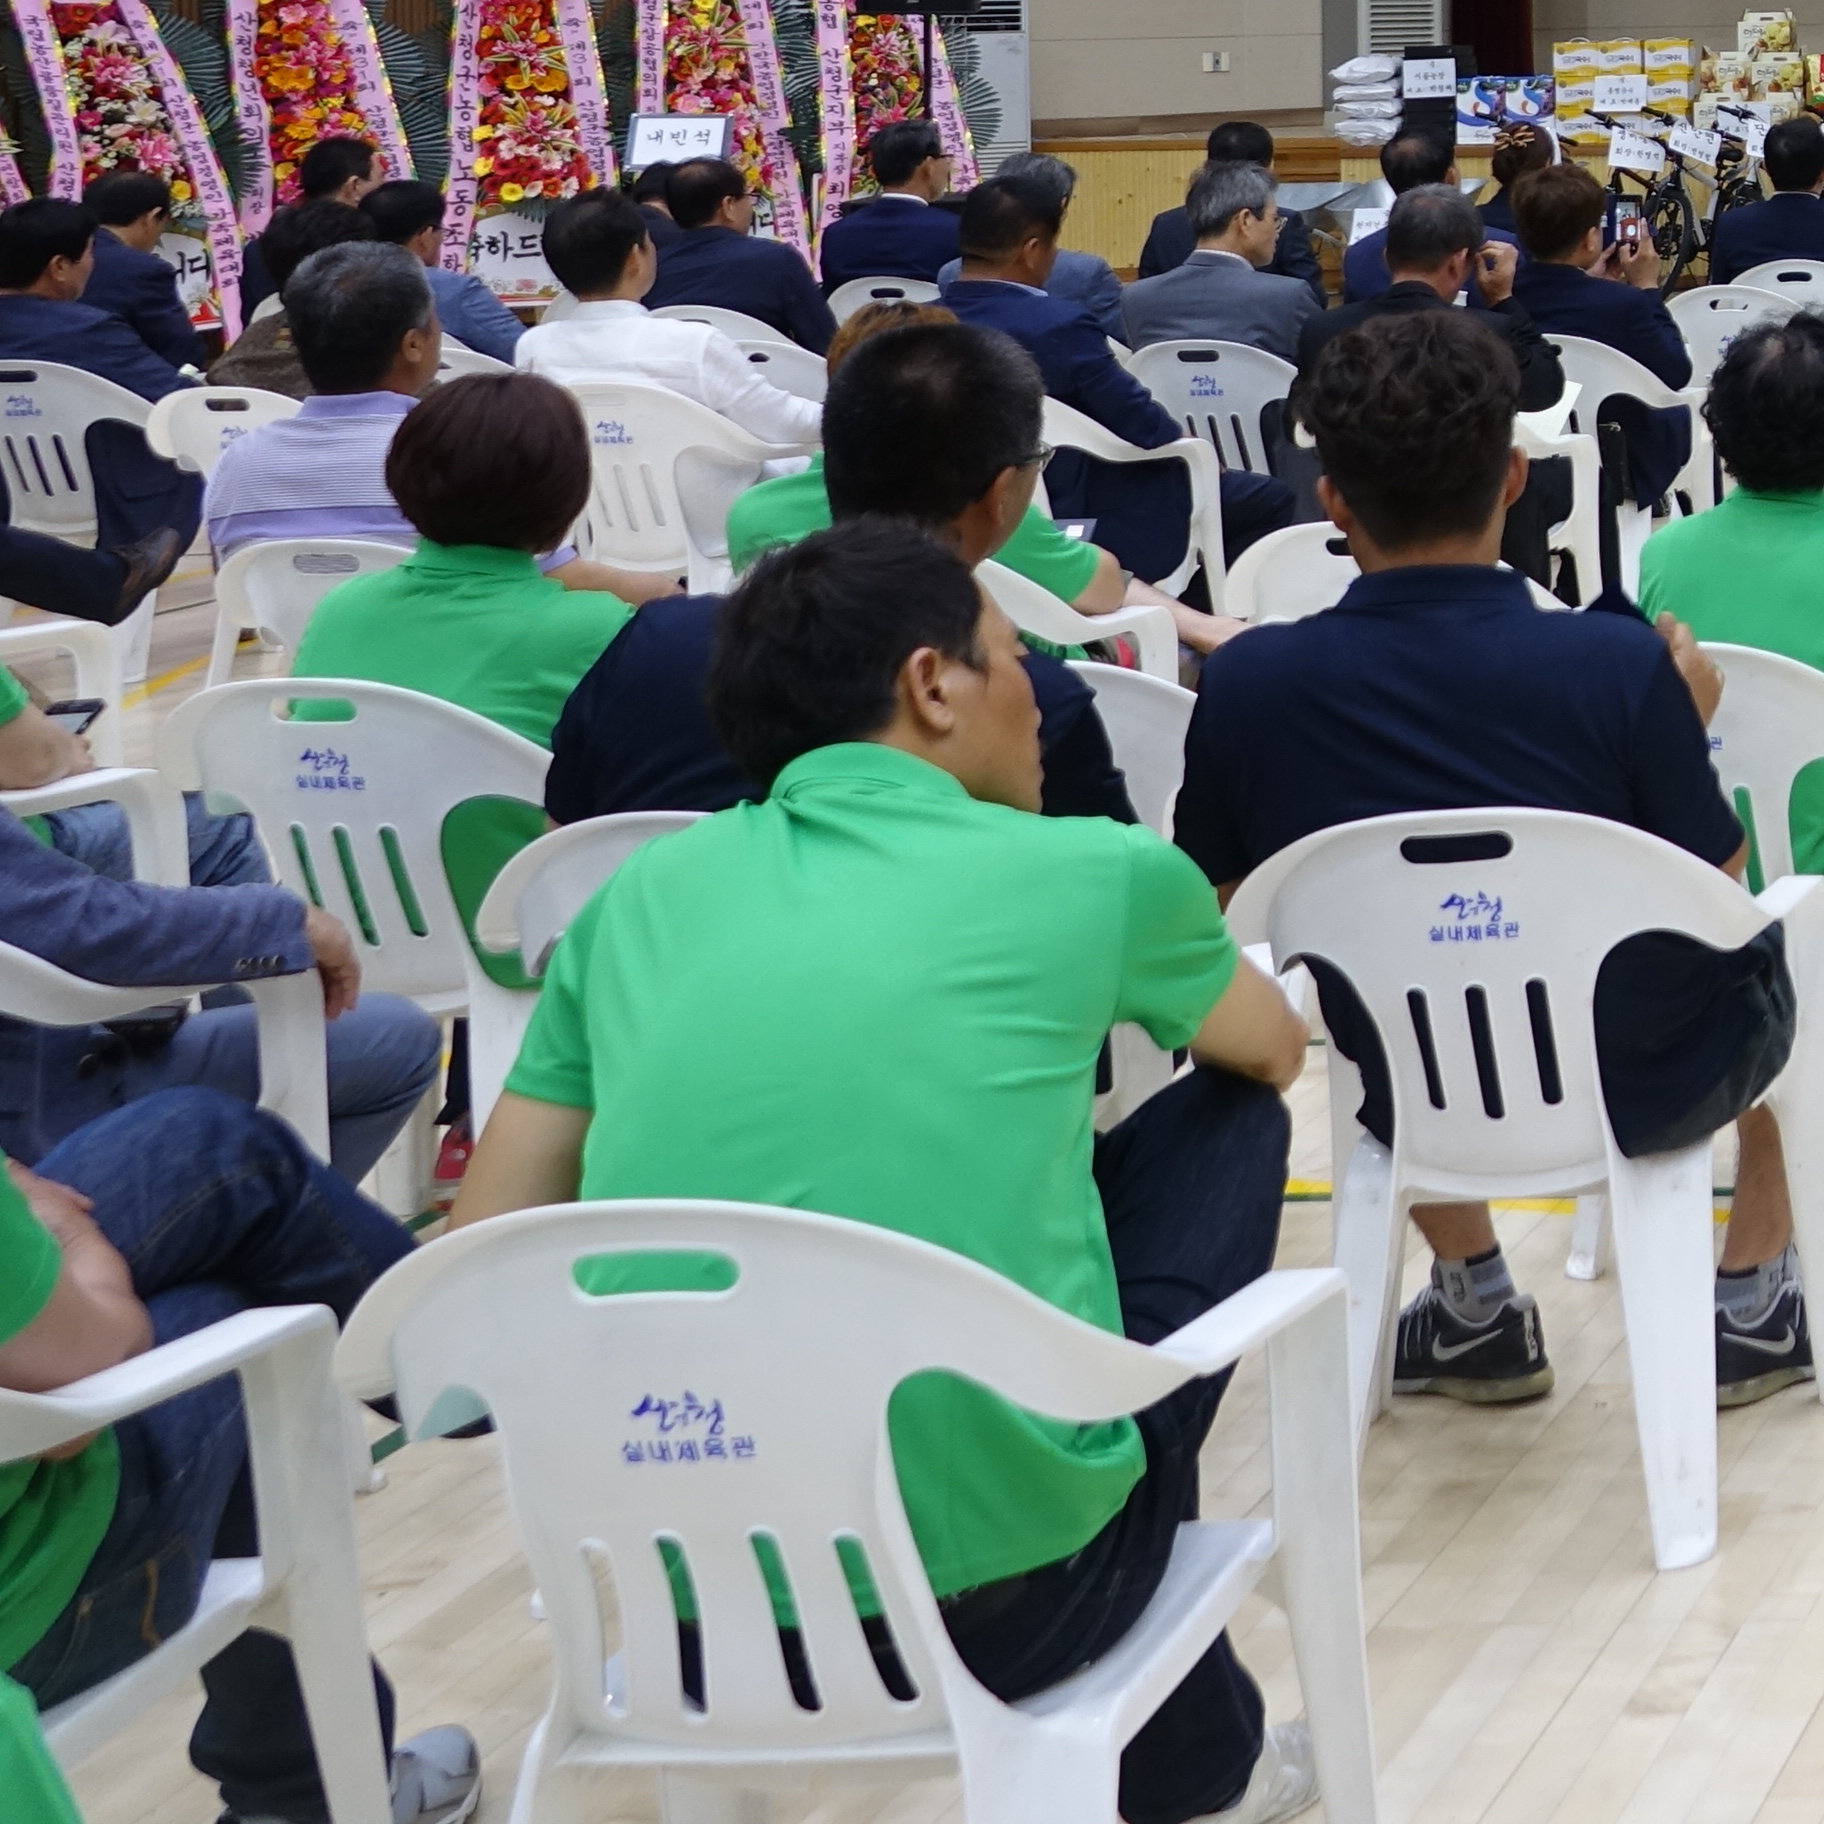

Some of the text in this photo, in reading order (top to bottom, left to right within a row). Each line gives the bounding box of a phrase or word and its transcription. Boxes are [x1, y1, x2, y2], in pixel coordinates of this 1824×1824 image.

[295, 774, 366, 791] 실내체육관
[1429, 921, 1521, 942] 실내체육관
[621, 1434, 758, 1464] 실내체육관
